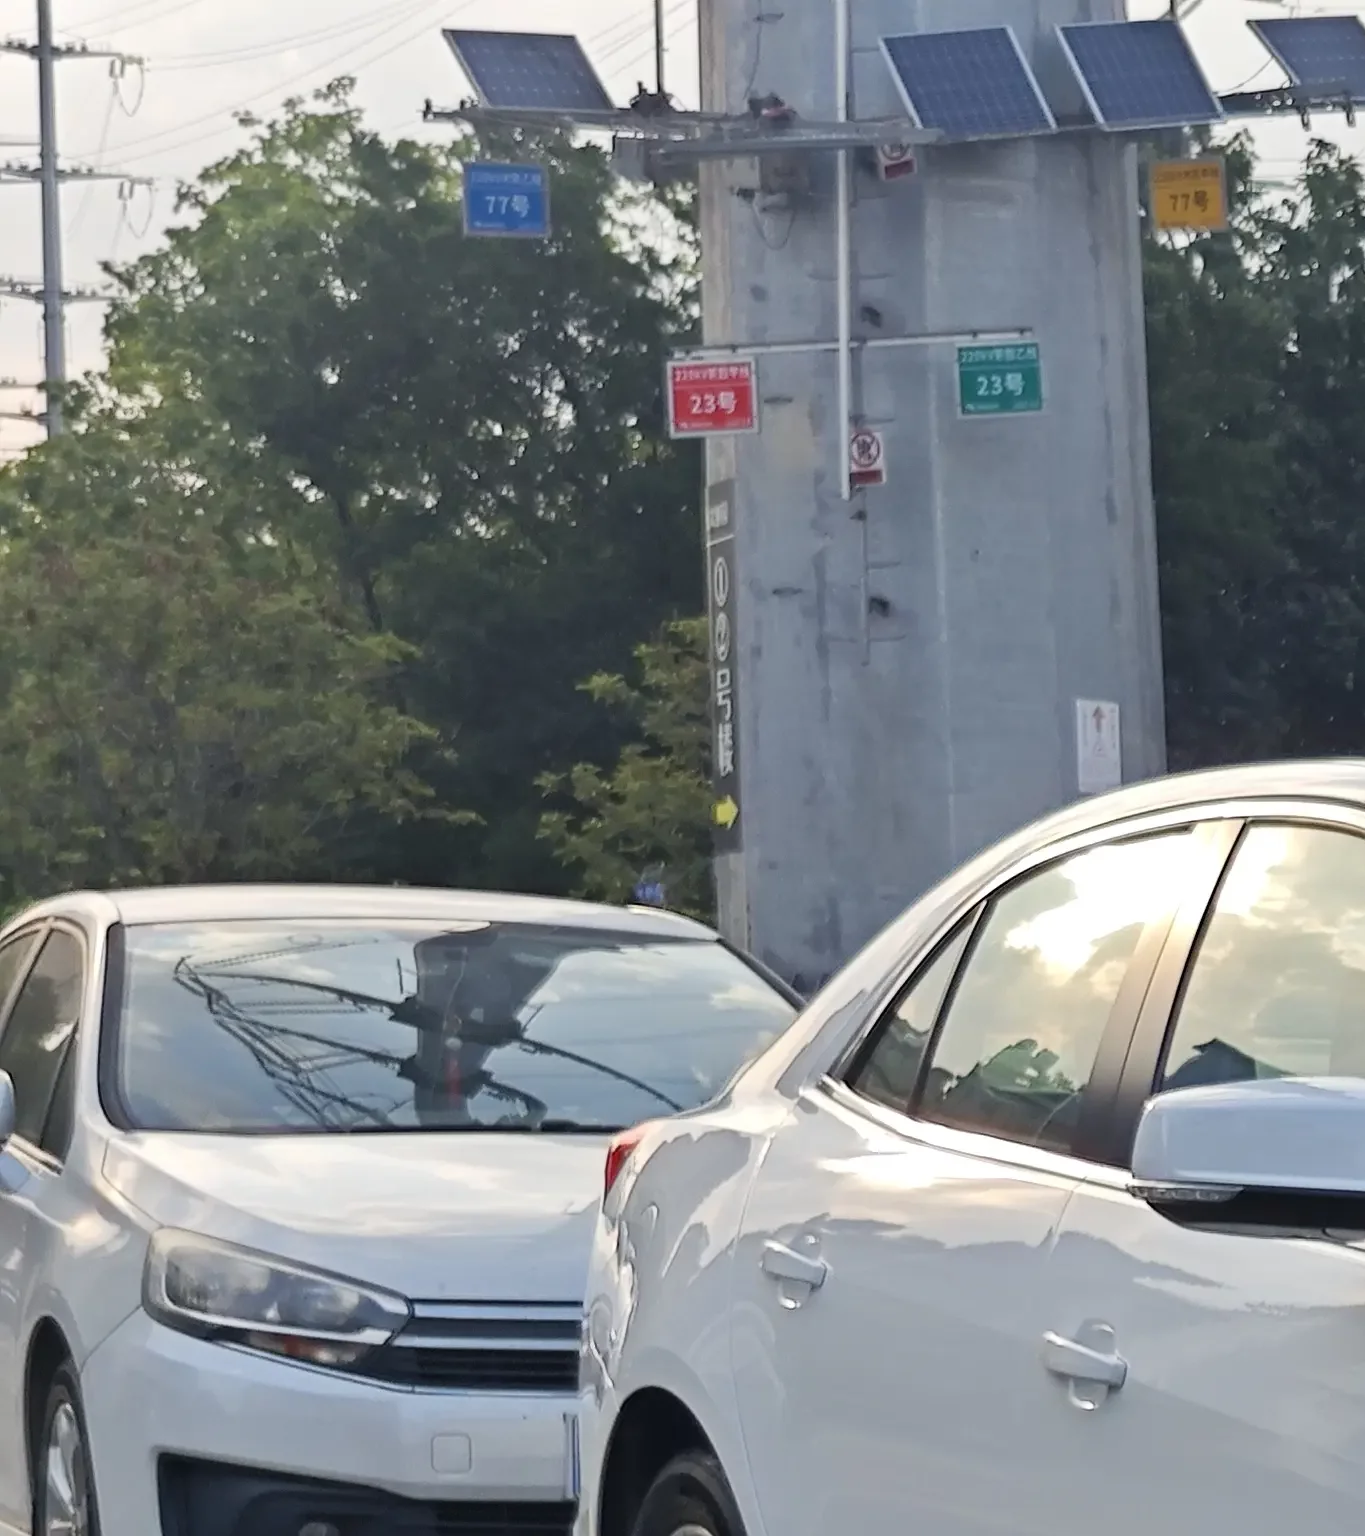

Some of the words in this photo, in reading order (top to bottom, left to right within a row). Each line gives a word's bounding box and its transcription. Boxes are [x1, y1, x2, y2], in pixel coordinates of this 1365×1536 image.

[485, 194, 530, 218] 77号
[1169, 190, 1209, 213] 77号
[976, 372, 1026, 397] 23号
[690, 391, 737, 415] 23号
